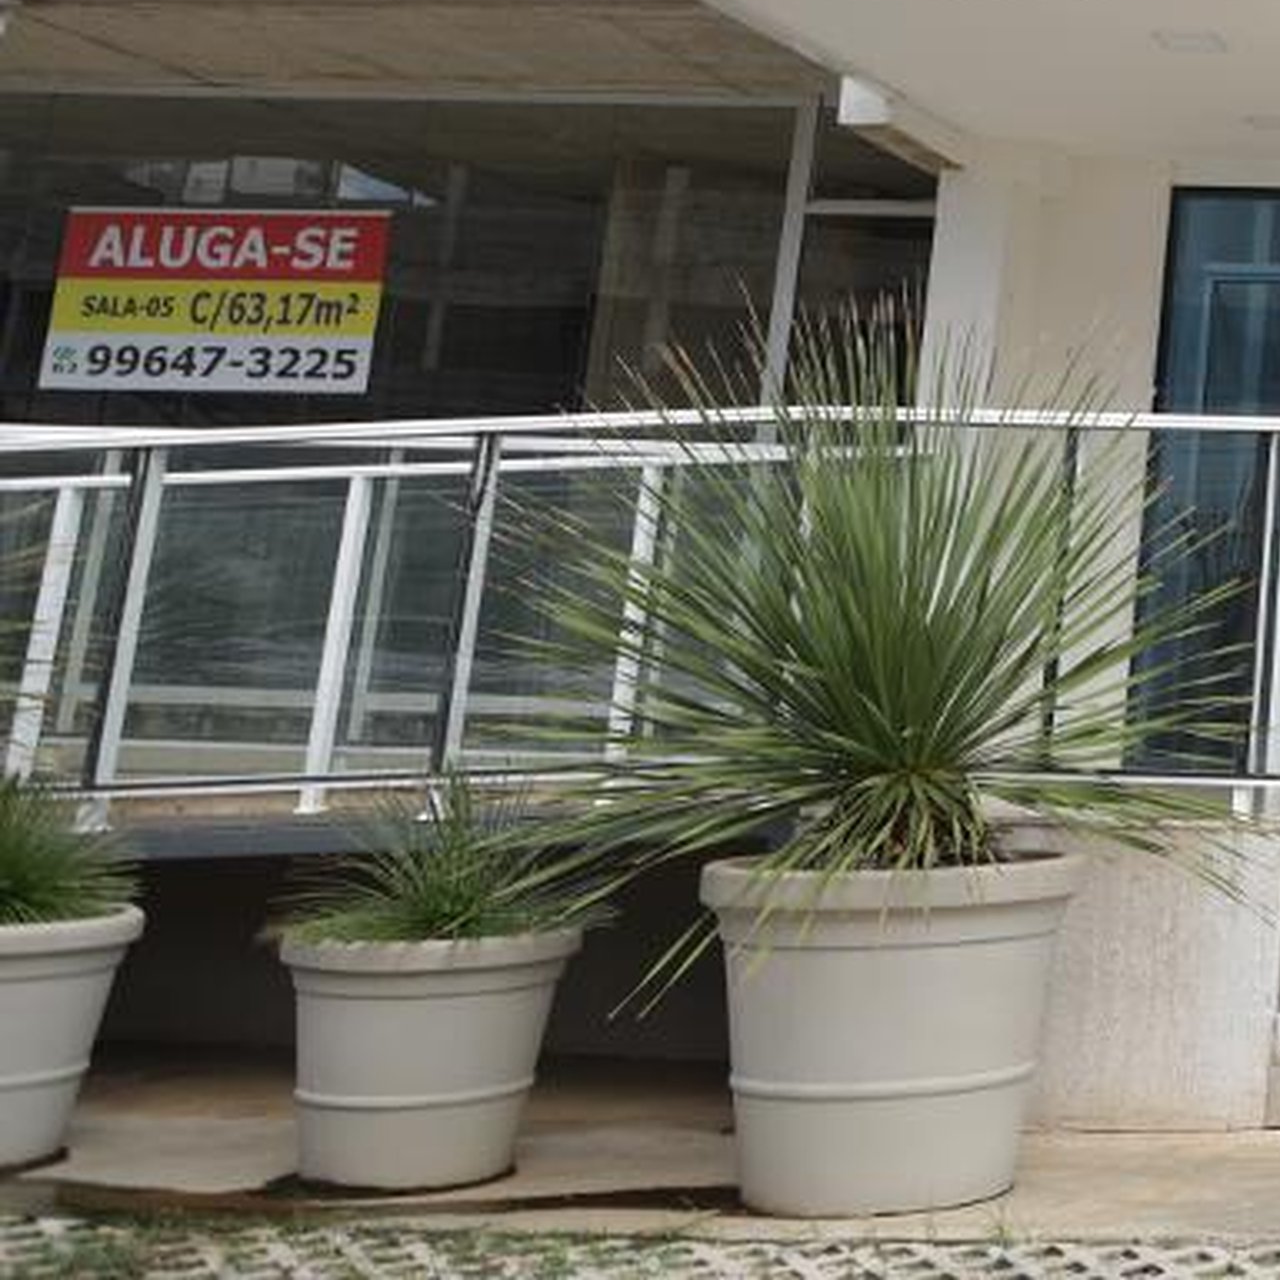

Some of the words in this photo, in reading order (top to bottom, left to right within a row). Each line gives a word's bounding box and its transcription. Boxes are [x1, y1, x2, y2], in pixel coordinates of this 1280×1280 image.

[89, 225, 361, 270] ALUGA-SE
[81, 294, 176, 319] SALA-05
[86, 344, 358, 380] 99647-3225
